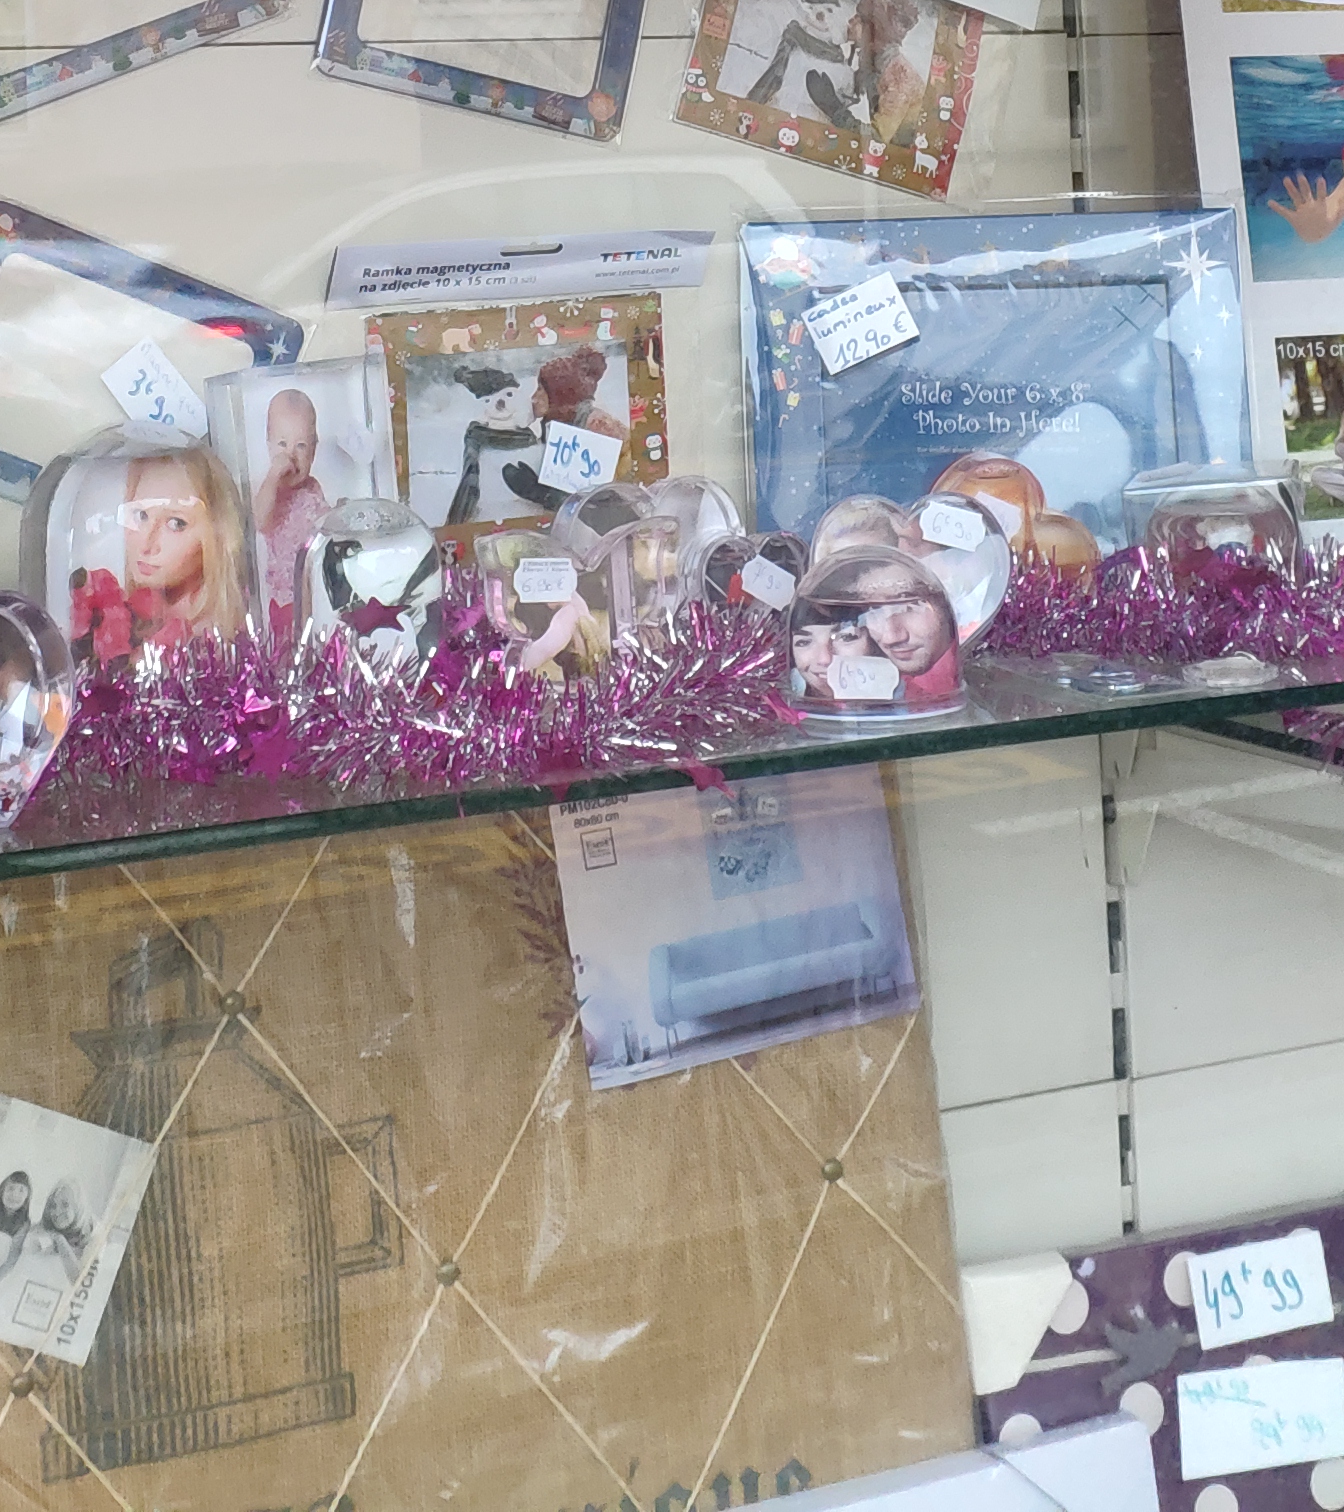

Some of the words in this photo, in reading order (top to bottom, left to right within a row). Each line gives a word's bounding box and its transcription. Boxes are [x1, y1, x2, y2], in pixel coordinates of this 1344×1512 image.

[600, 247, 683, 263] TETENAL
[362, 265, 413, 279] Ramka
[416, 261, 511, 277] magnetyczna
[594, 265, 681, 278] www.tetenal.com.pl
[358, 283, 377, 294] na
[436, 278, 451, 288] 10
[467, 276, 482, 286] 15
[485, 275, 507, 285] cm
[1276, 340, 1324, 360] 10x15
[901, 381, 953, 406] Slide
[961, 381, 1017, 406] Your
[913, 409, 981, 436] Photo
[988, 411, 1011, 433] In
[1017, 409, 1081, 437] Here!
